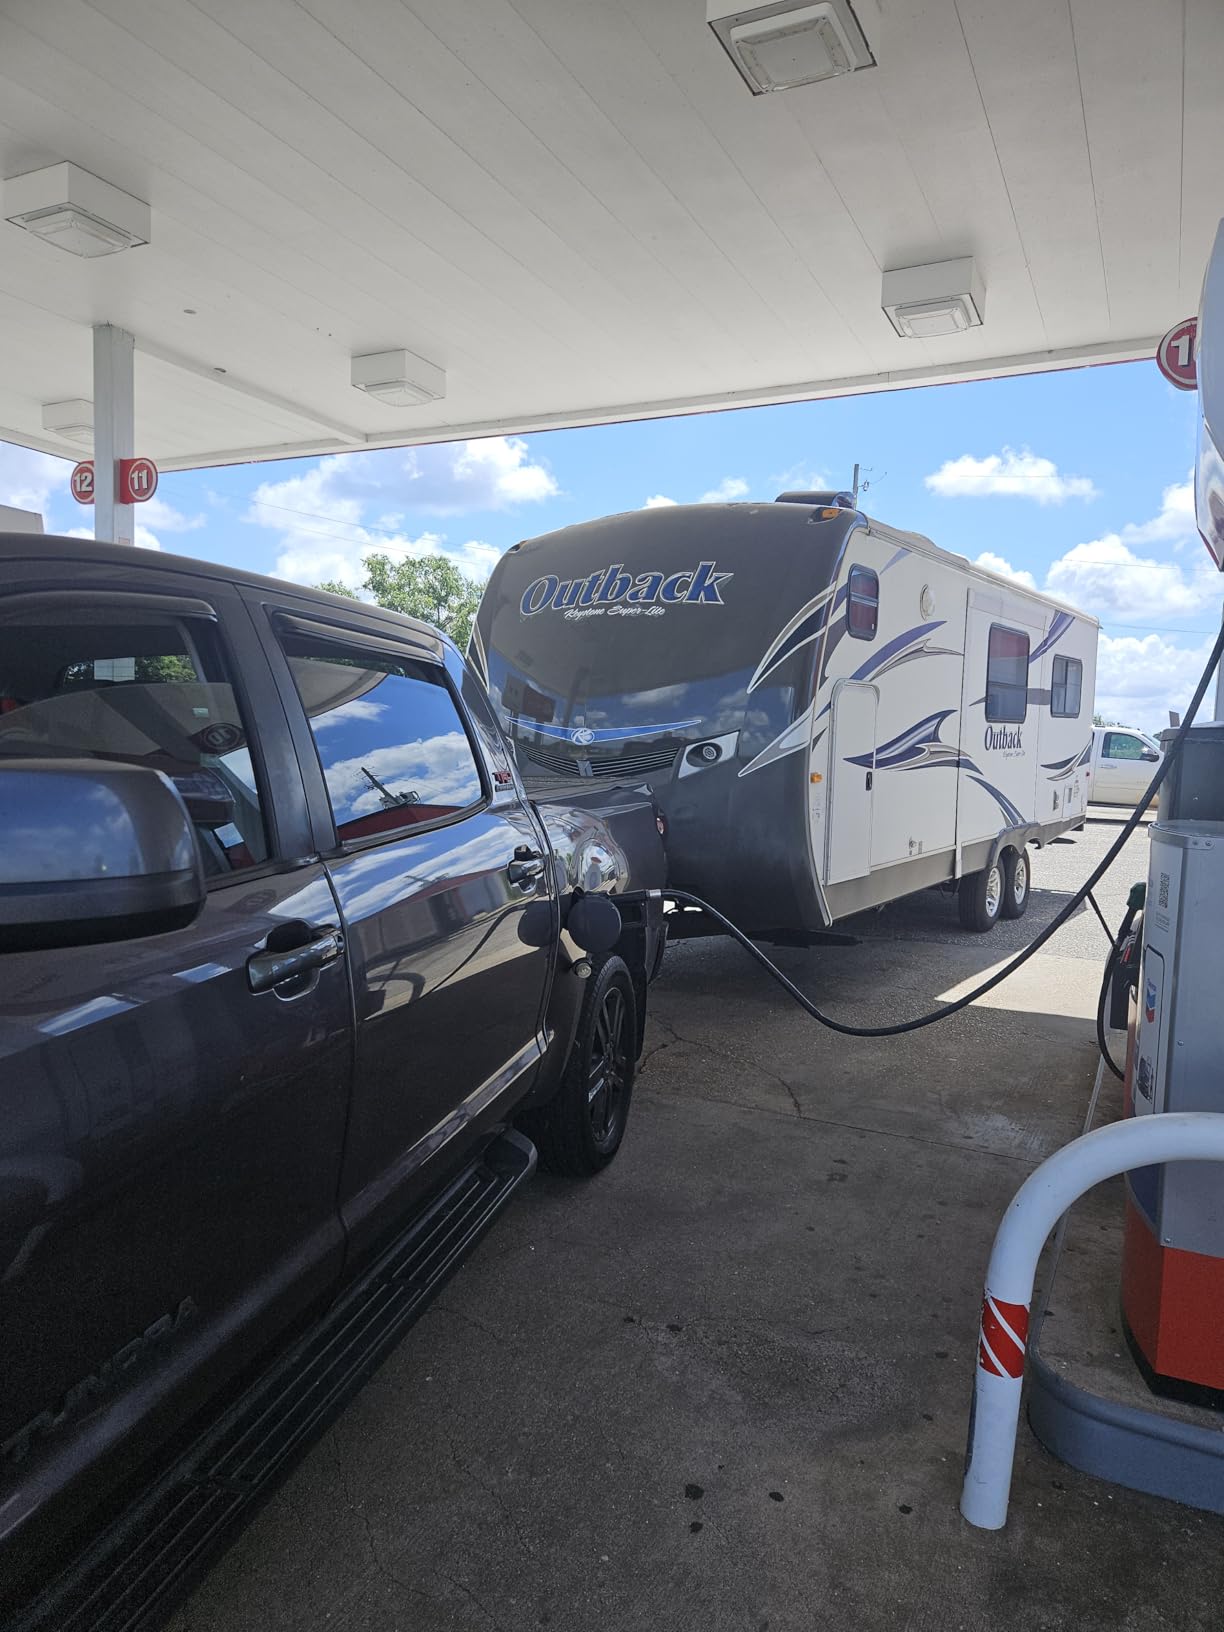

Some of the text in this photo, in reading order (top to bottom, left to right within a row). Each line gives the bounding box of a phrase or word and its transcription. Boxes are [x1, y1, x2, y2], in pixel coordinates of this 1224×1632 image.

[1170, 335, 1197, 367] 1
[75, 473, 92, 492] 12
[132, 469, 148, 490] 11
[520, 561, 735, 616] Outback
[564, 608, 605, 621] Keystone
[985, 725, 1022, 751] Outback
